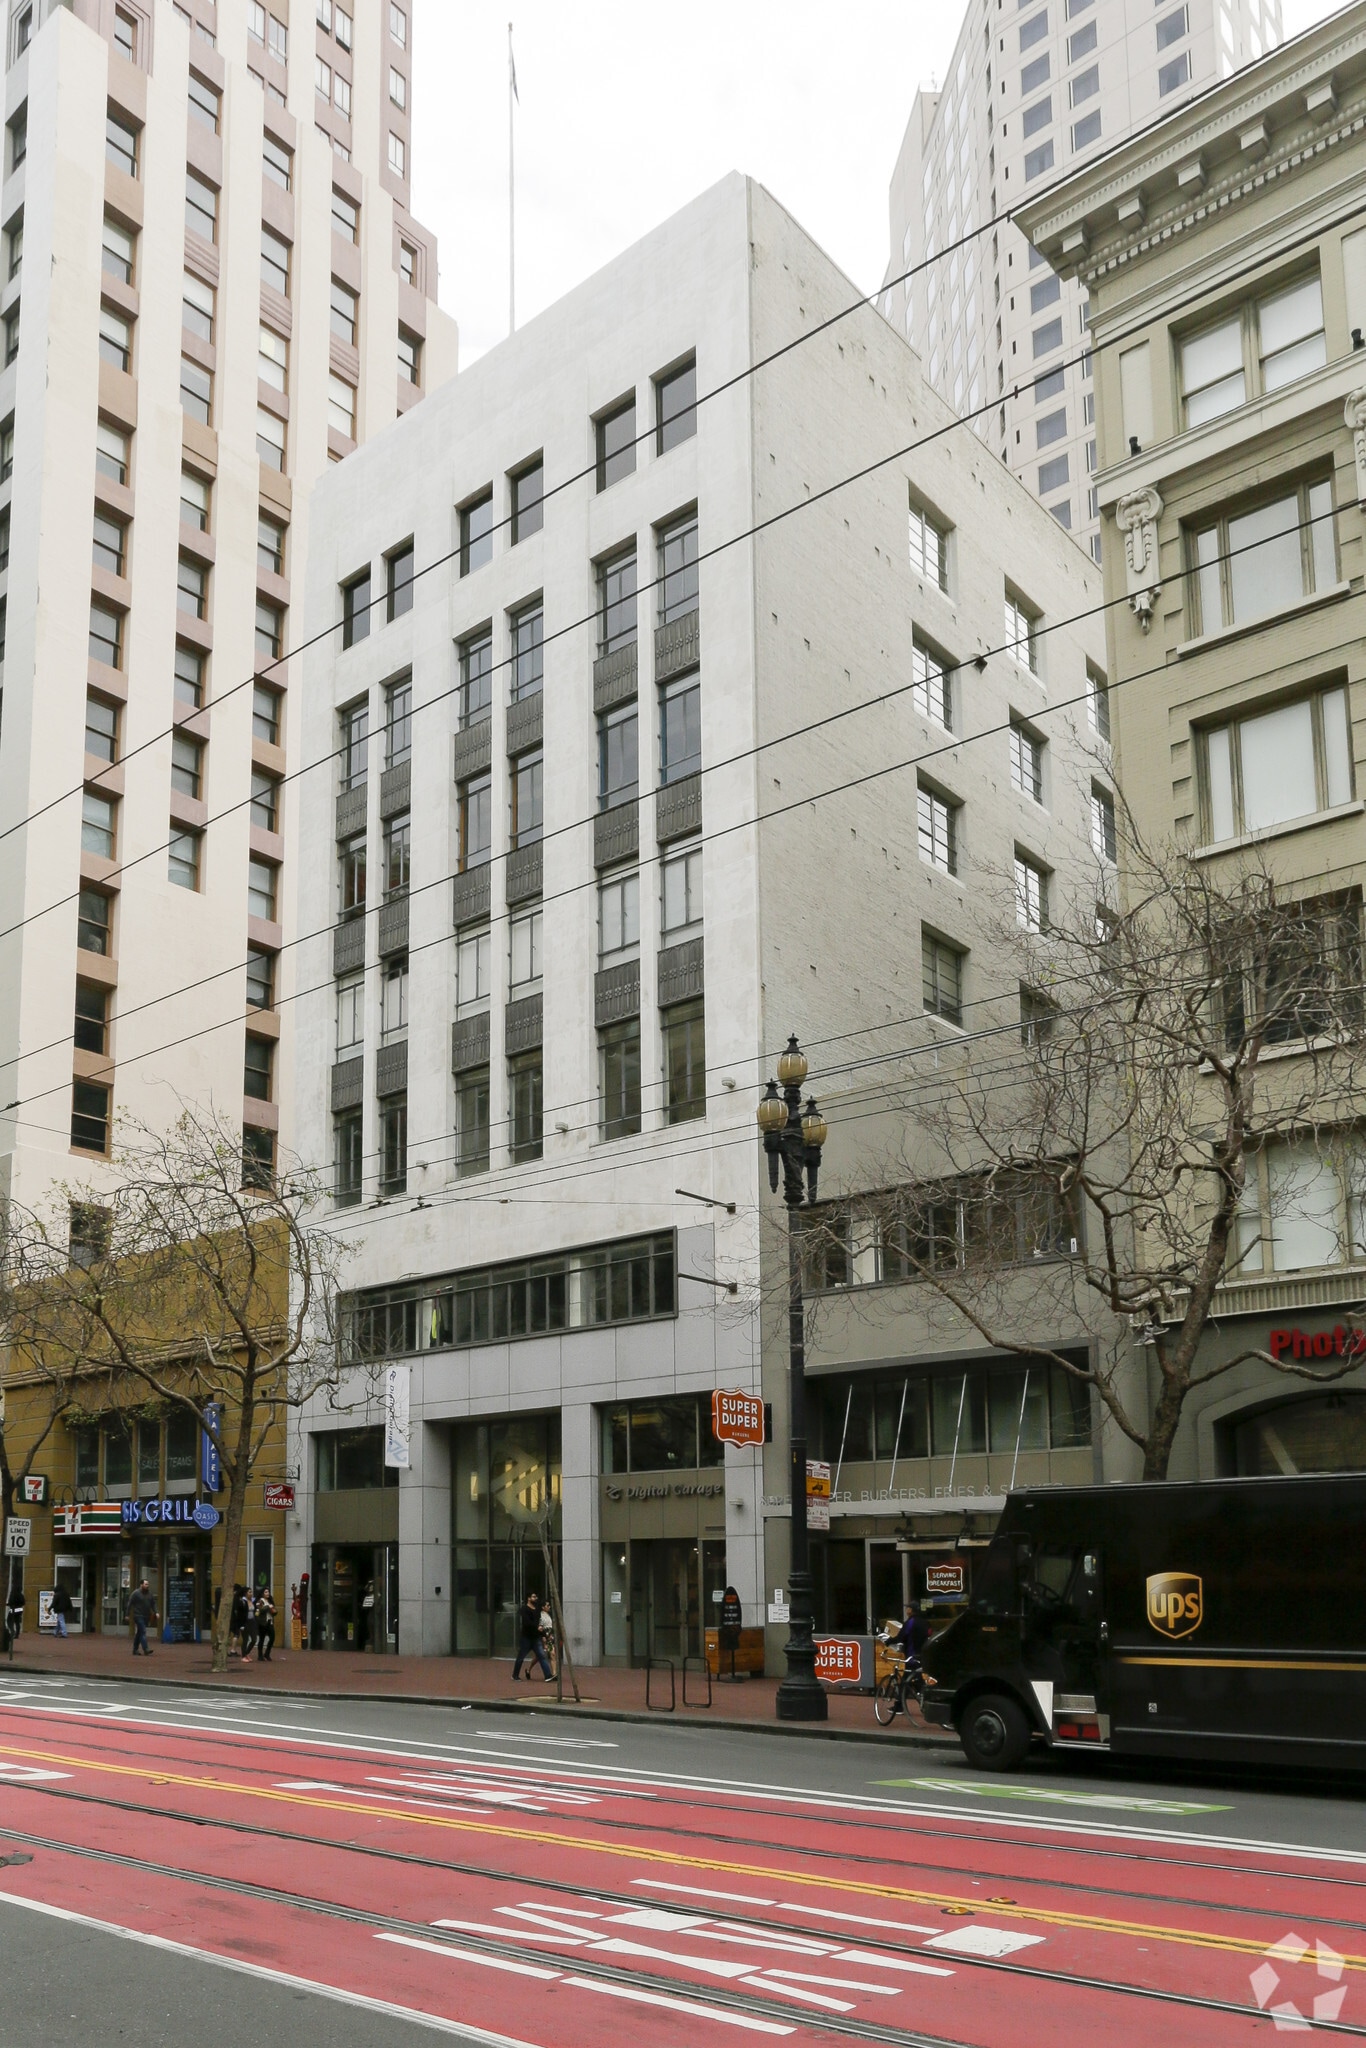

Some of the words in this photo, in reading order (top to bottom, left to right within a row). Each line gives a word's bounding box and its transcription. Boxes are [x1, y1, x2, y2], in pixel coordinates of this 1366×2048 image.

[722, 1398, 758, 1415] SUPER
[722, 1412, 758, 1429] DUPER
[210, 1410, 218, 1482] FAAFEL
[28, 1479, 42, 1501] 7
[625, 1484, 669, 1500] Digital
[673, 1484, 721, 1497] Garage
[860, 1487, 927, 1503] BURGERS
[934, 1485, 975, 1498] FRIES
[982, 1484, 992, 1497] &
[266, 1497, 293, 1507] CIGARS
[195, 1511, 217, 1521] OASIS
[10, 1535, 26, 1548] 10
[1151, 1592, 1200, 1629] ups
[819, 1645, 853, 1657] UPER
